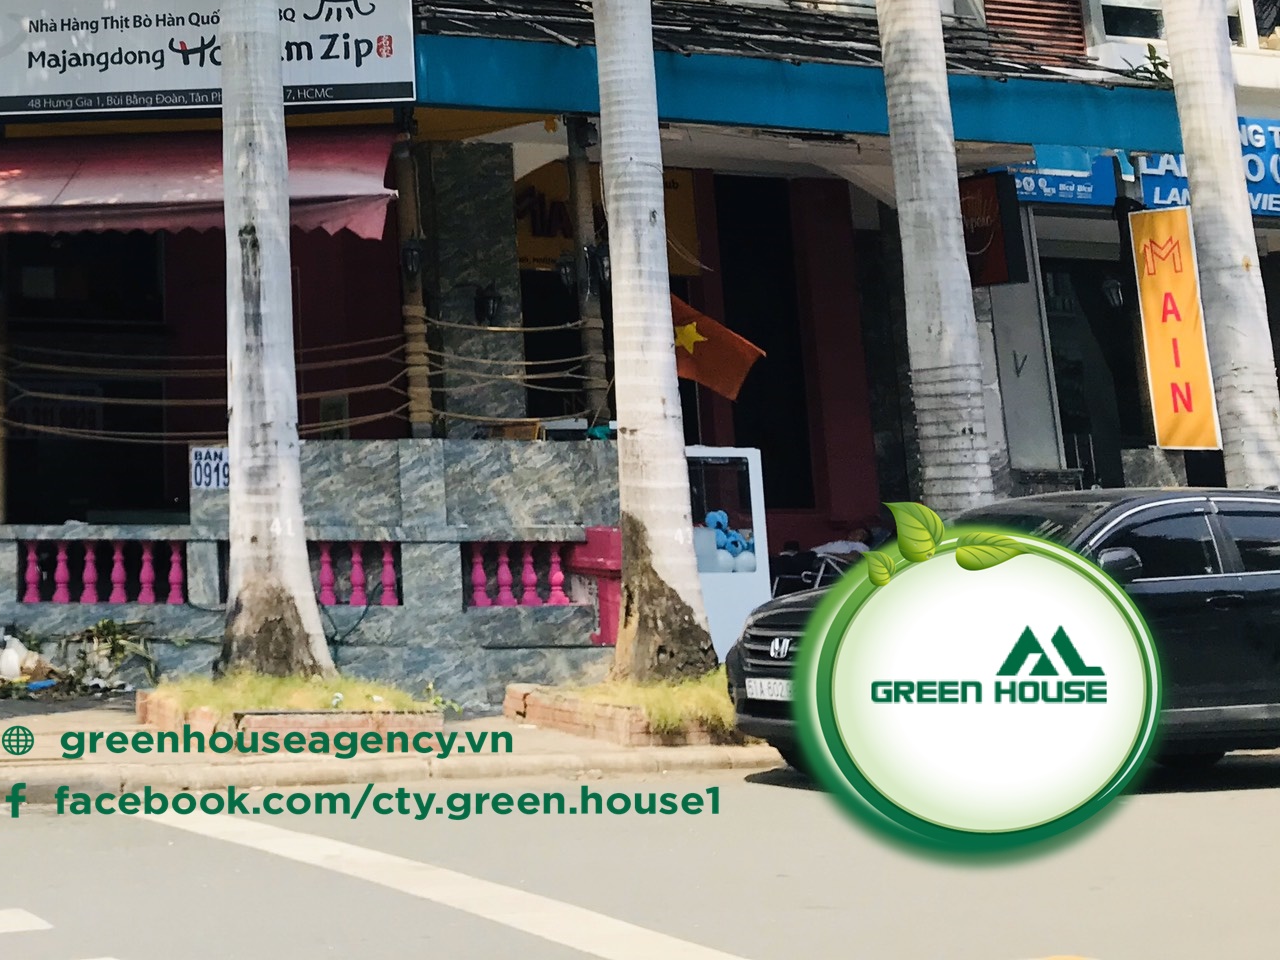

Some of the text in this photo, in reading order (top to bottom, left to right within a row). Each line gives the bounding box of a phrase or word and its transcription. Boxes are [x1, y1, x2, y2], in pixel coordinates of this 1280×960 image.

[28, 19, 57, 33] Nhà
[60, 17, 99, 34] Hàng
[101, 15, 129, 33] Thịt
[133, 14, 152, 28] Bò
[155, 13, 185, 27] Hàn
[188, 9, 221, 27] Quố
[28, 47, 165, 74] Majangdong
[320, 32, 373, 67] Zip
[28, 99, 41, 109] 48
[75, 97, 93, 107] Gia
[298, 87, 333, 99] HCMC
[1144, 236, 1194, 414] MAIN
[194, 462, 230, 487] 0919
